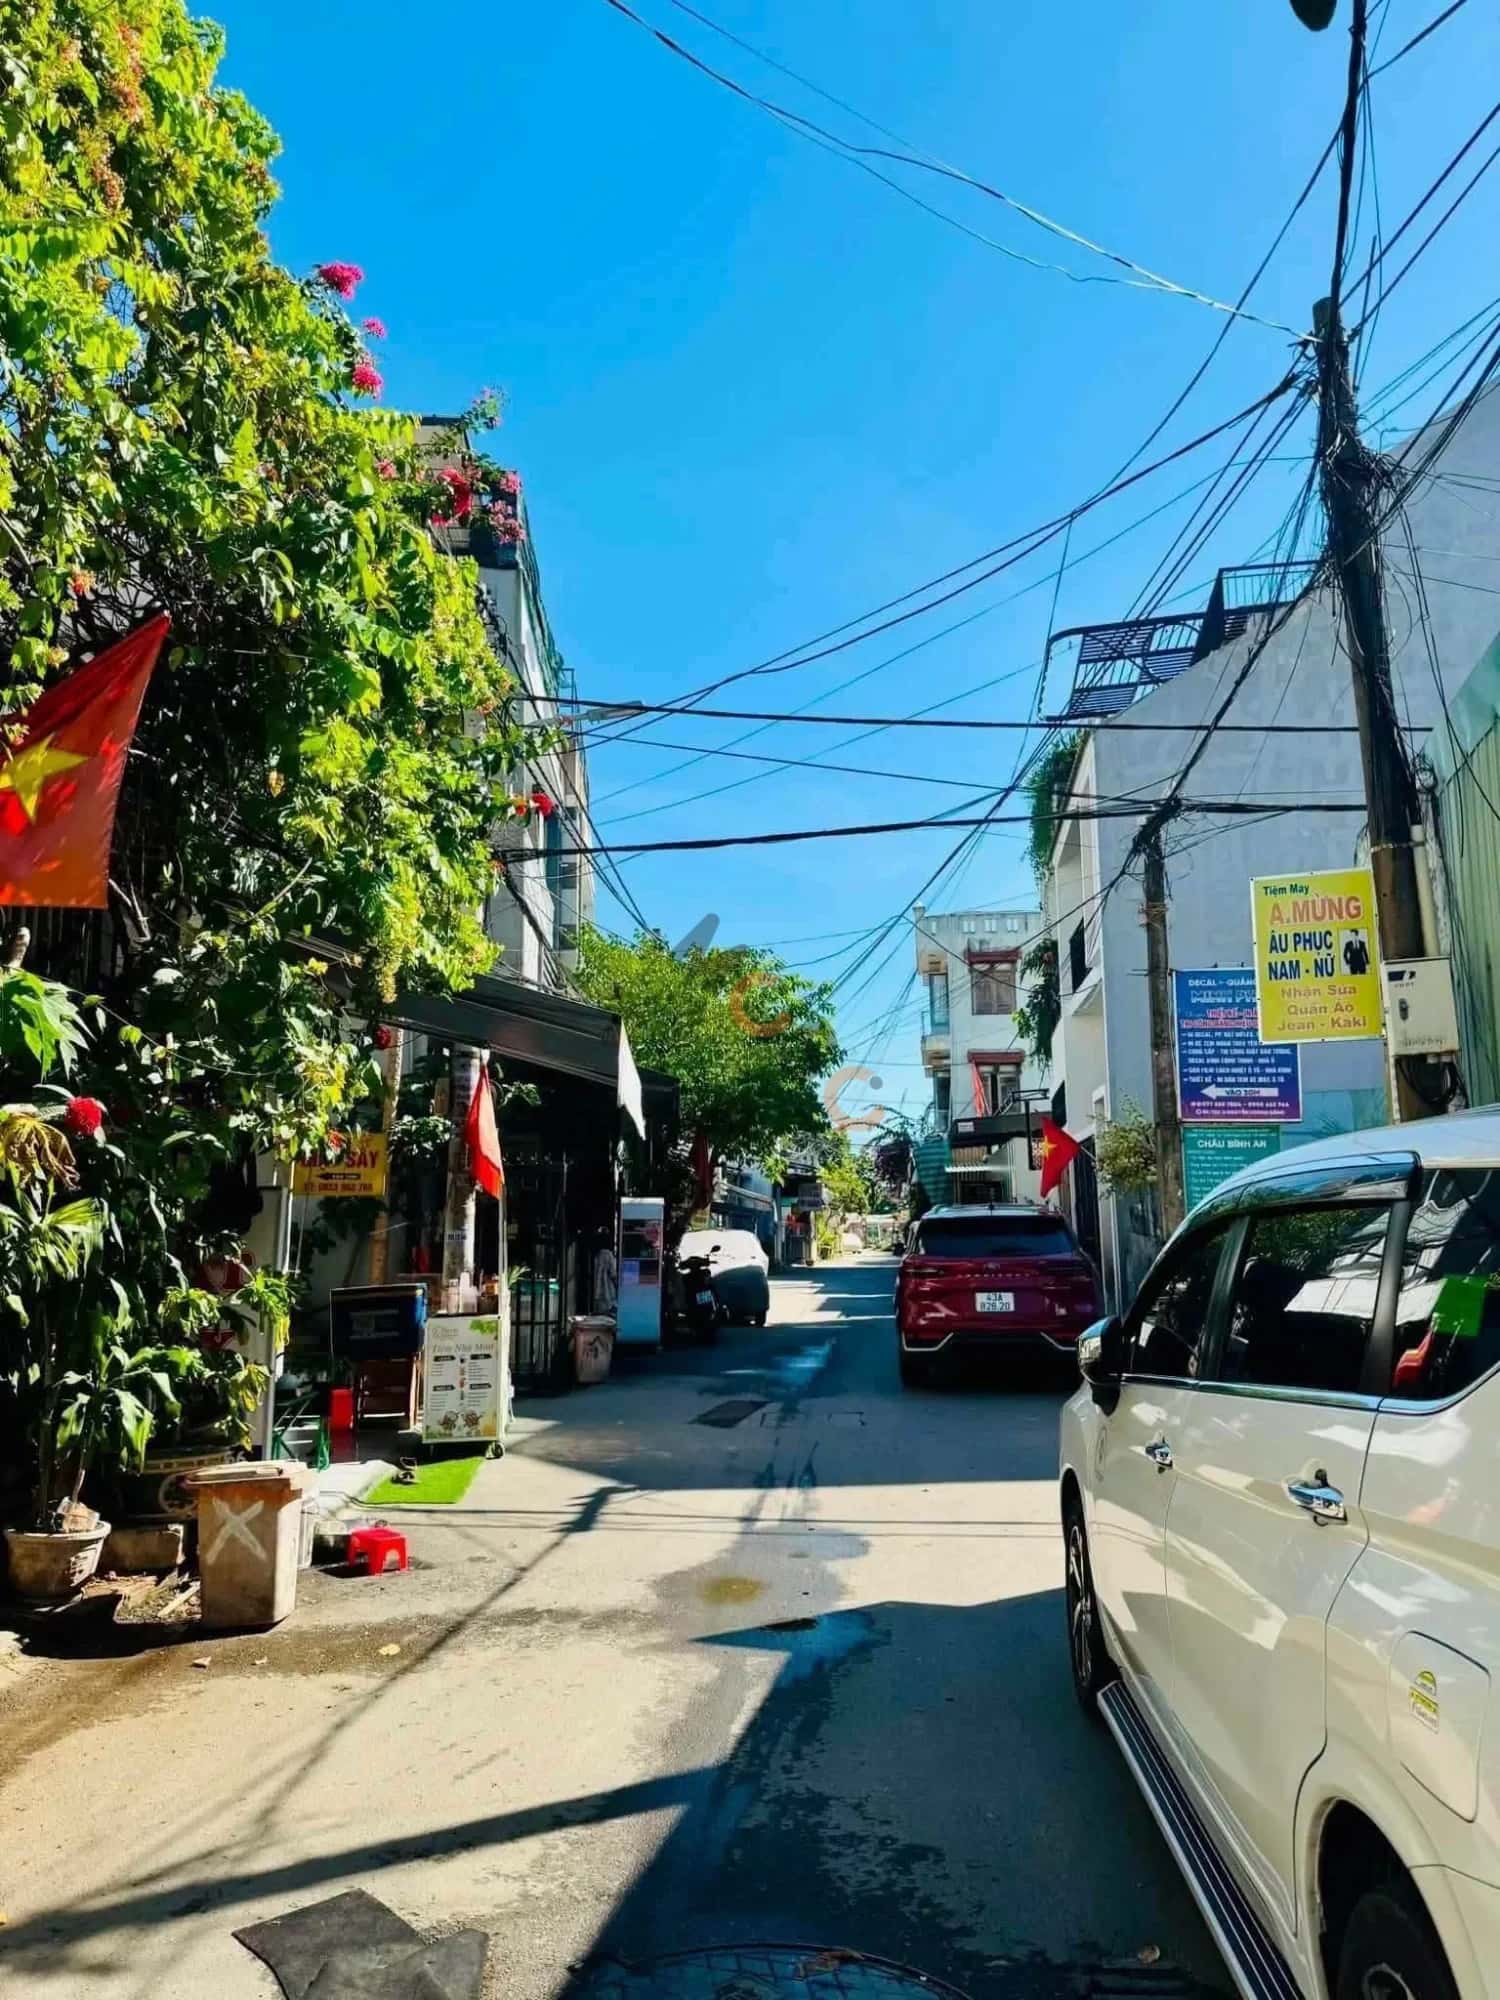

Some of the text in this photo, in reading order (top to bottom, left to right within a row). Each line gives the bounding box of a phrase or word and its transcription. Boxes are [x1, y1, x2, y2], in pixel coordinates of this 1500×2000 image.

[1289, 884, 1310, 896] May
[1293, 930, 1334, 956] PHỤC
[1268, 960, 1301, 981] NAM
[1314, 952, 1337, 978] NỮ
[1277, 1020, 1315, 1031] Jean
[1331, 1016, 1367, 1029] Kaki
[1253, 1140, 1266, 1149] AN
